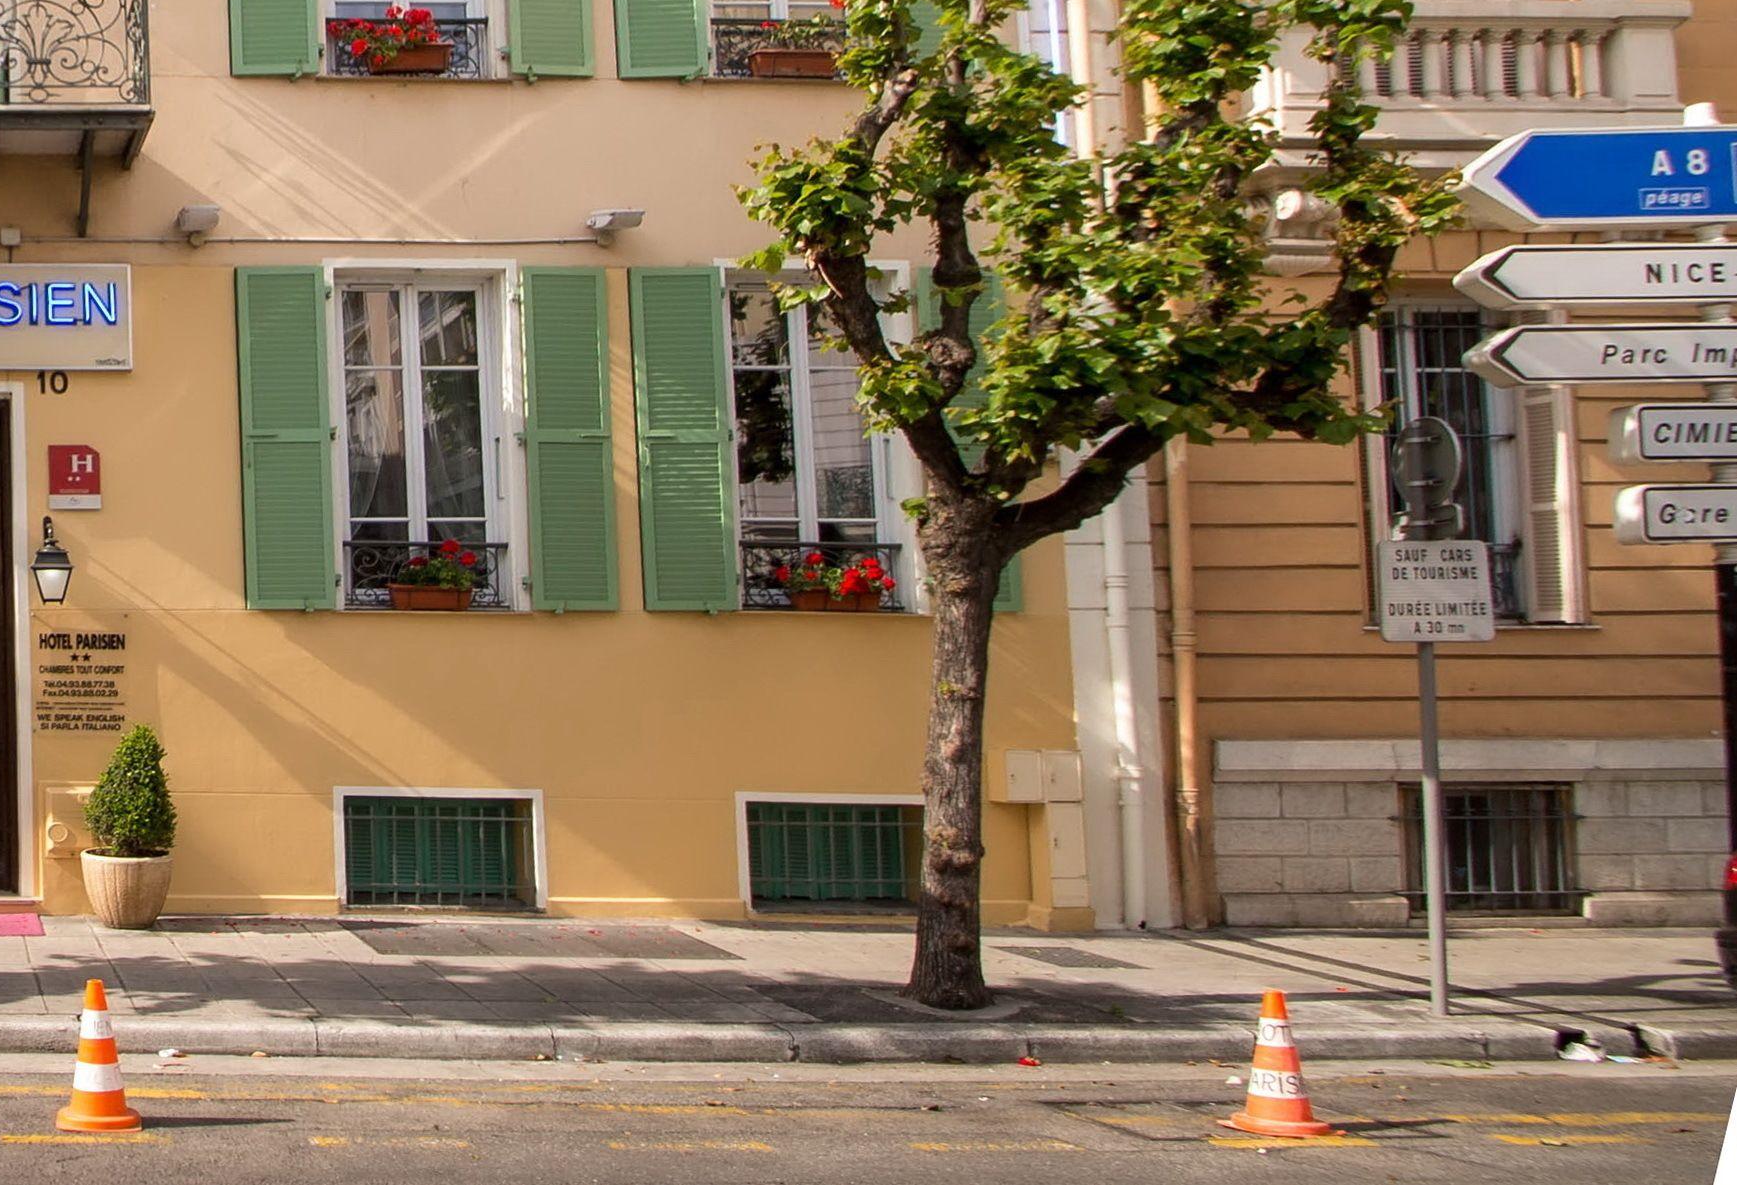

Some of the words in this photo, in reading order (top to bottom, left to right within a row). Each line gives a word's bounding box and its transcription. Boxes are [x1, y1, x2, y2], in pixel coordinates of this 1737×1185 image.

[1651, 149, 1676, 176] A
[1686, 149, 1710, 175] 8
[1644, 190, 1703, 209] péage
[1601, 344, 1668, 364] Parc
[37, 370, 69, 394] 10
[1654, 422, 1737, 444] CIMIE
[70, 454, 93, 473] H
[1395, 549, 1428, 562] SAUF
[1440, 549, 1472, 562] CARS
[1392, 567, 1409, 580] DE
[1413, 567, 1478, 580] TOURISME
[1388, 600, 1432, 616] DURÉE
[1435, 600, 1487, 616] LIMITÉE
[1426, 621, 1443, 634] 30
[39, 633, 73, 650] HOTEL
[76, 633, 125, 650] PARISIEN
[39, 665, 74, 674] CHAMBRES
[76, 665, 92, 674] TOUT
[94, 665, 124, 674] CONFORT
[86, 714, 125, 722] ENGLISH
[82, 723, 121, 731] ITALIANO
